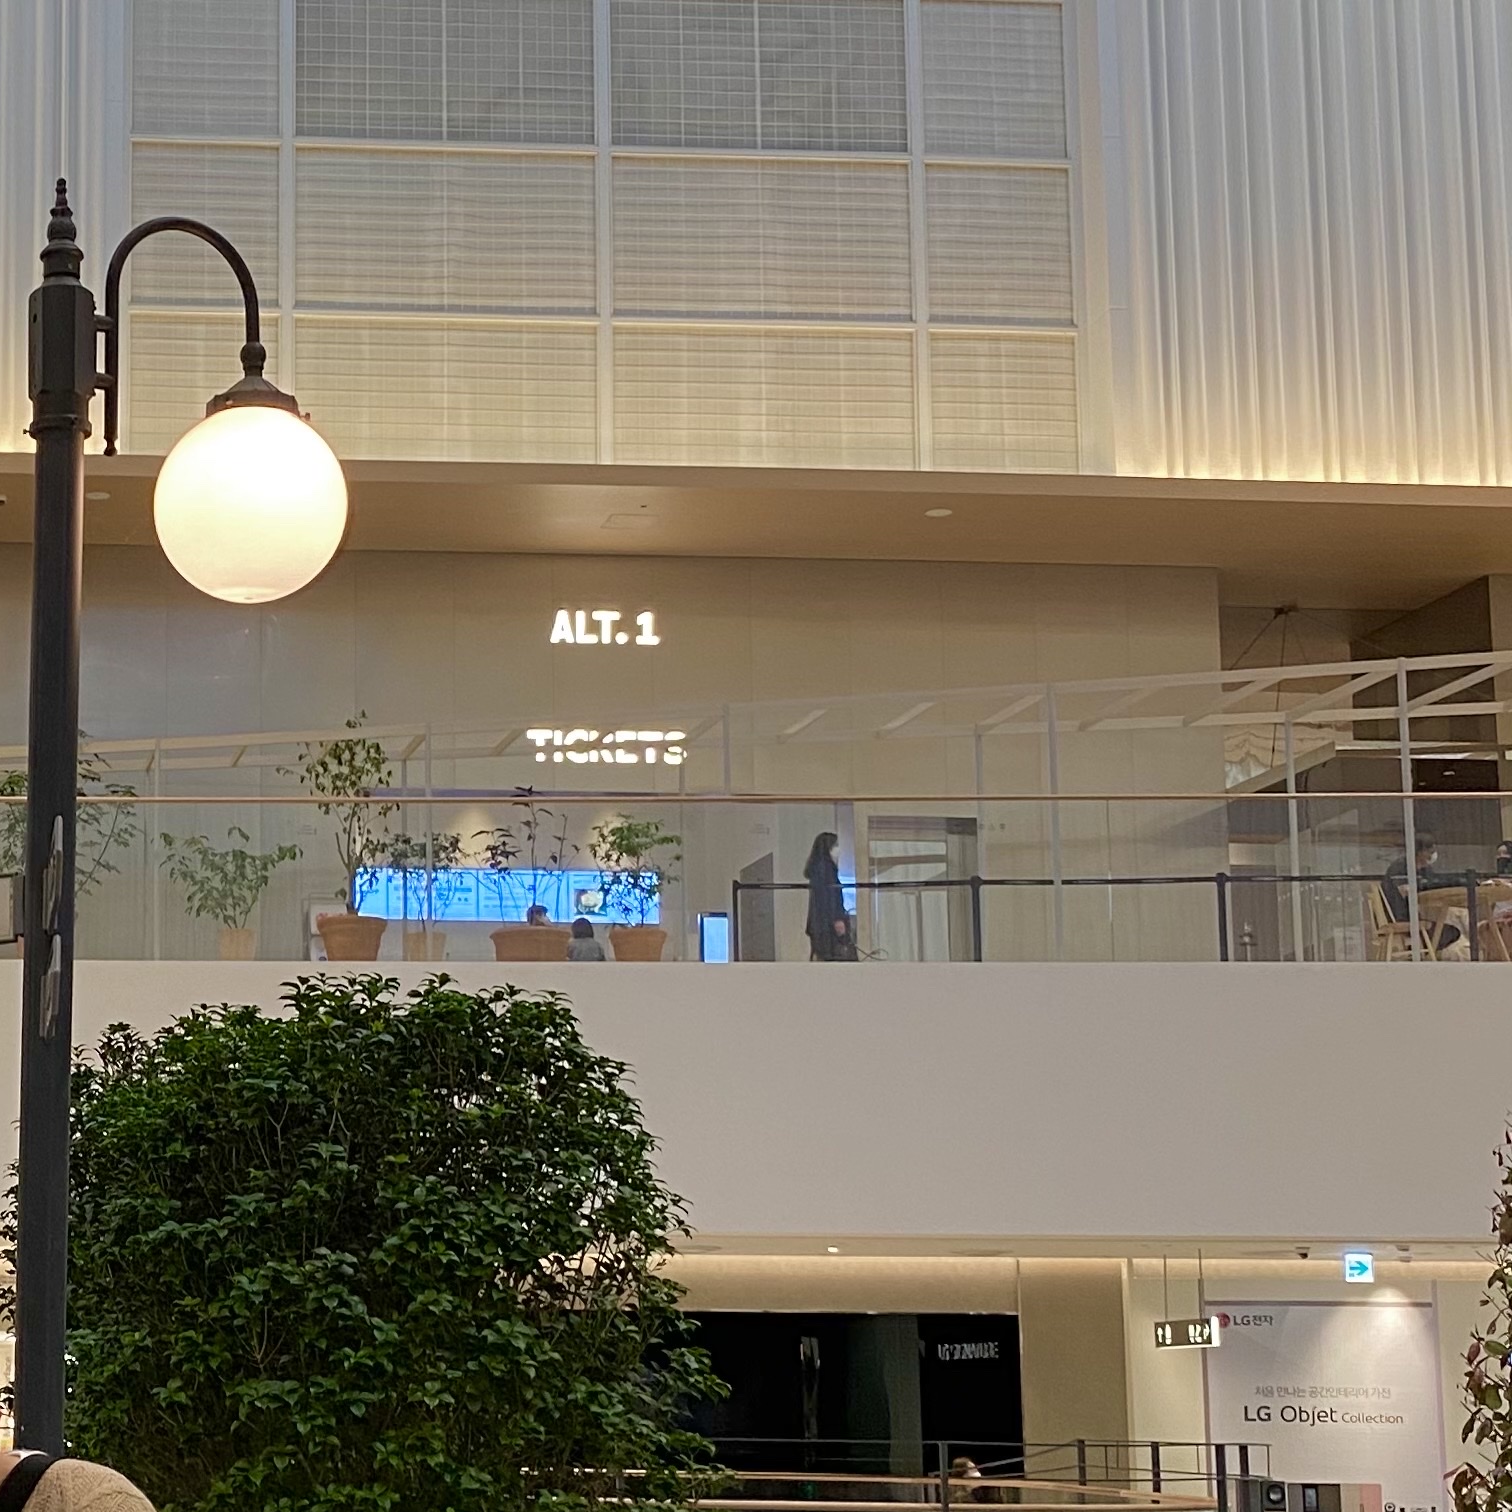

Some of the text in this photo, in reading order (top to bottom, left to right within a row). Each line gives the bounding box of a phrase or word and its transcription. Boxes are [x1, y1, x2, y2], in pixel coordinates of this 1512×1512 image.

[527, 729, 687, 764] TICKETS
[1244, 1405, 1404, 1427] LG Objet Collection
